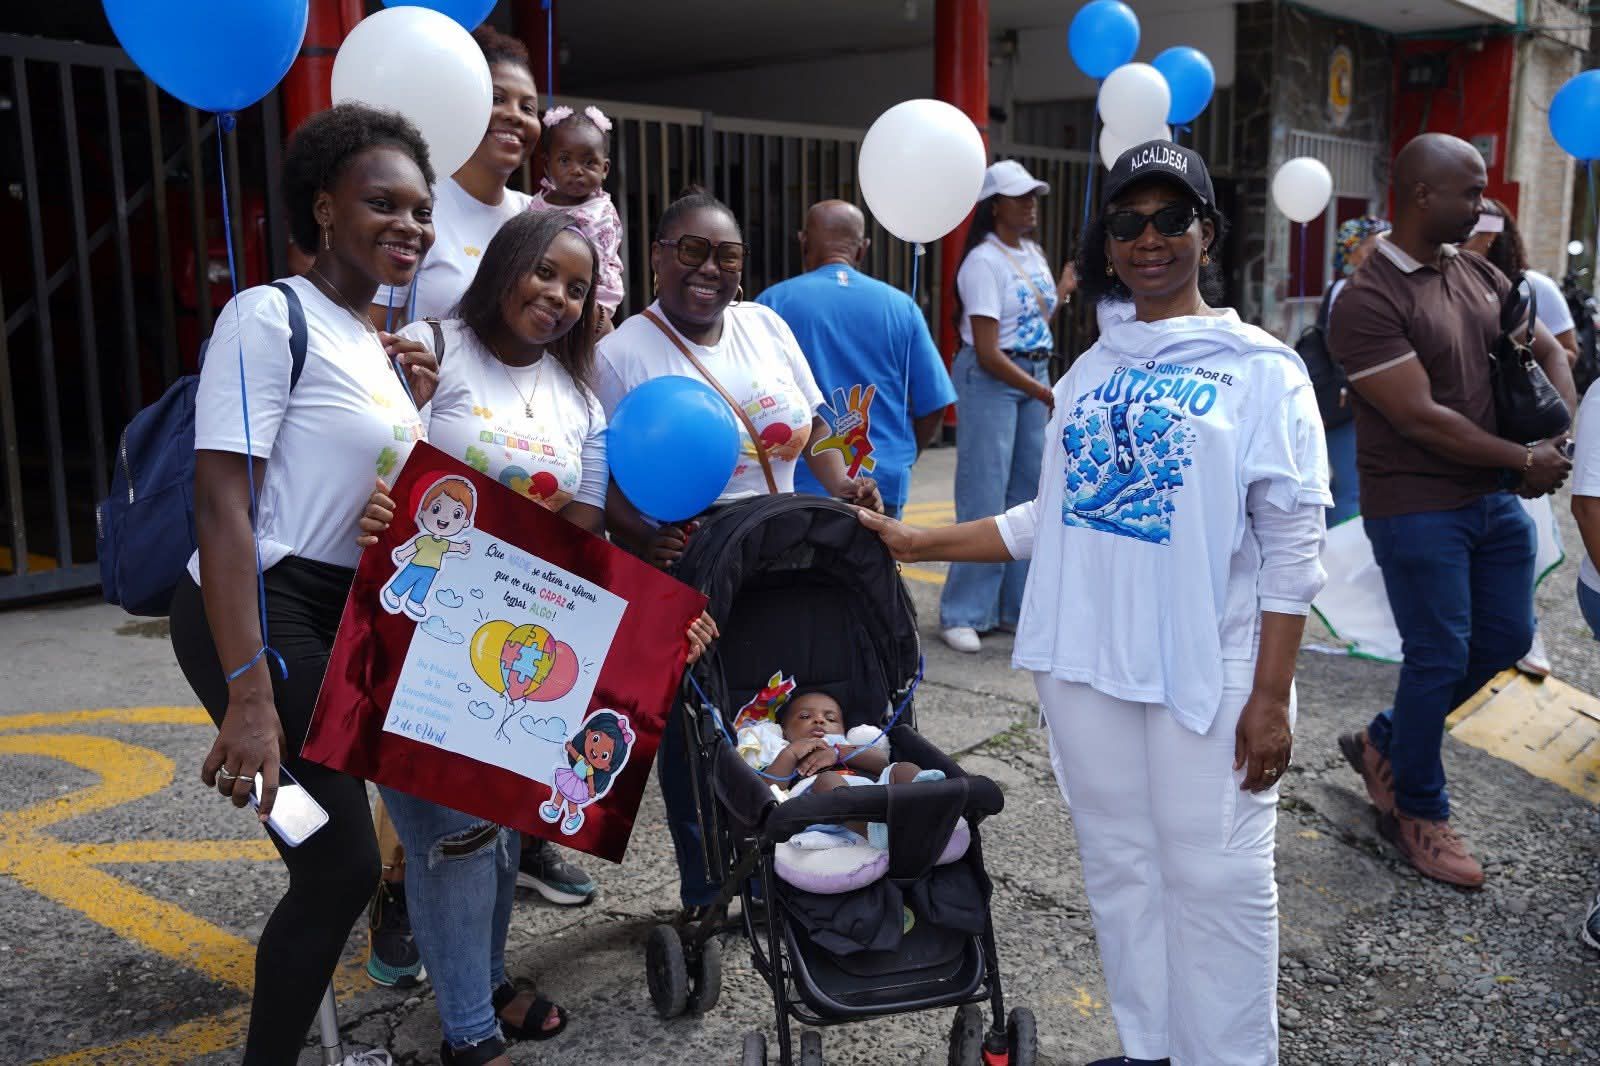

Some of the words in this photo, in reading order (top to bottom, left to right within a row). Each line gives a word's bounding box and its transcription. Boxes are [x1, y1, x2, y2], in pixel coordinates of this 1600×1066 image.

[1131, 145, 1188, 174] ALCALDESA
[1194, 367, 1220, 382] POR
[1220, 373, 1234, 387] EL
[485, 543, 505, 560] Que
[532, 567, 540, 576] se
[542, 571, 563, 587] atreva
[572, 583, 598, 603] afirmar
[494, 570, 510, 582] que
[511, 577, 521, 587] no
[539, 587, 567, 608] CAPAZ
[566, 600, 576, 612] de
[389, 714, 400, 726] 2
[400, 719, 413, 732] de
